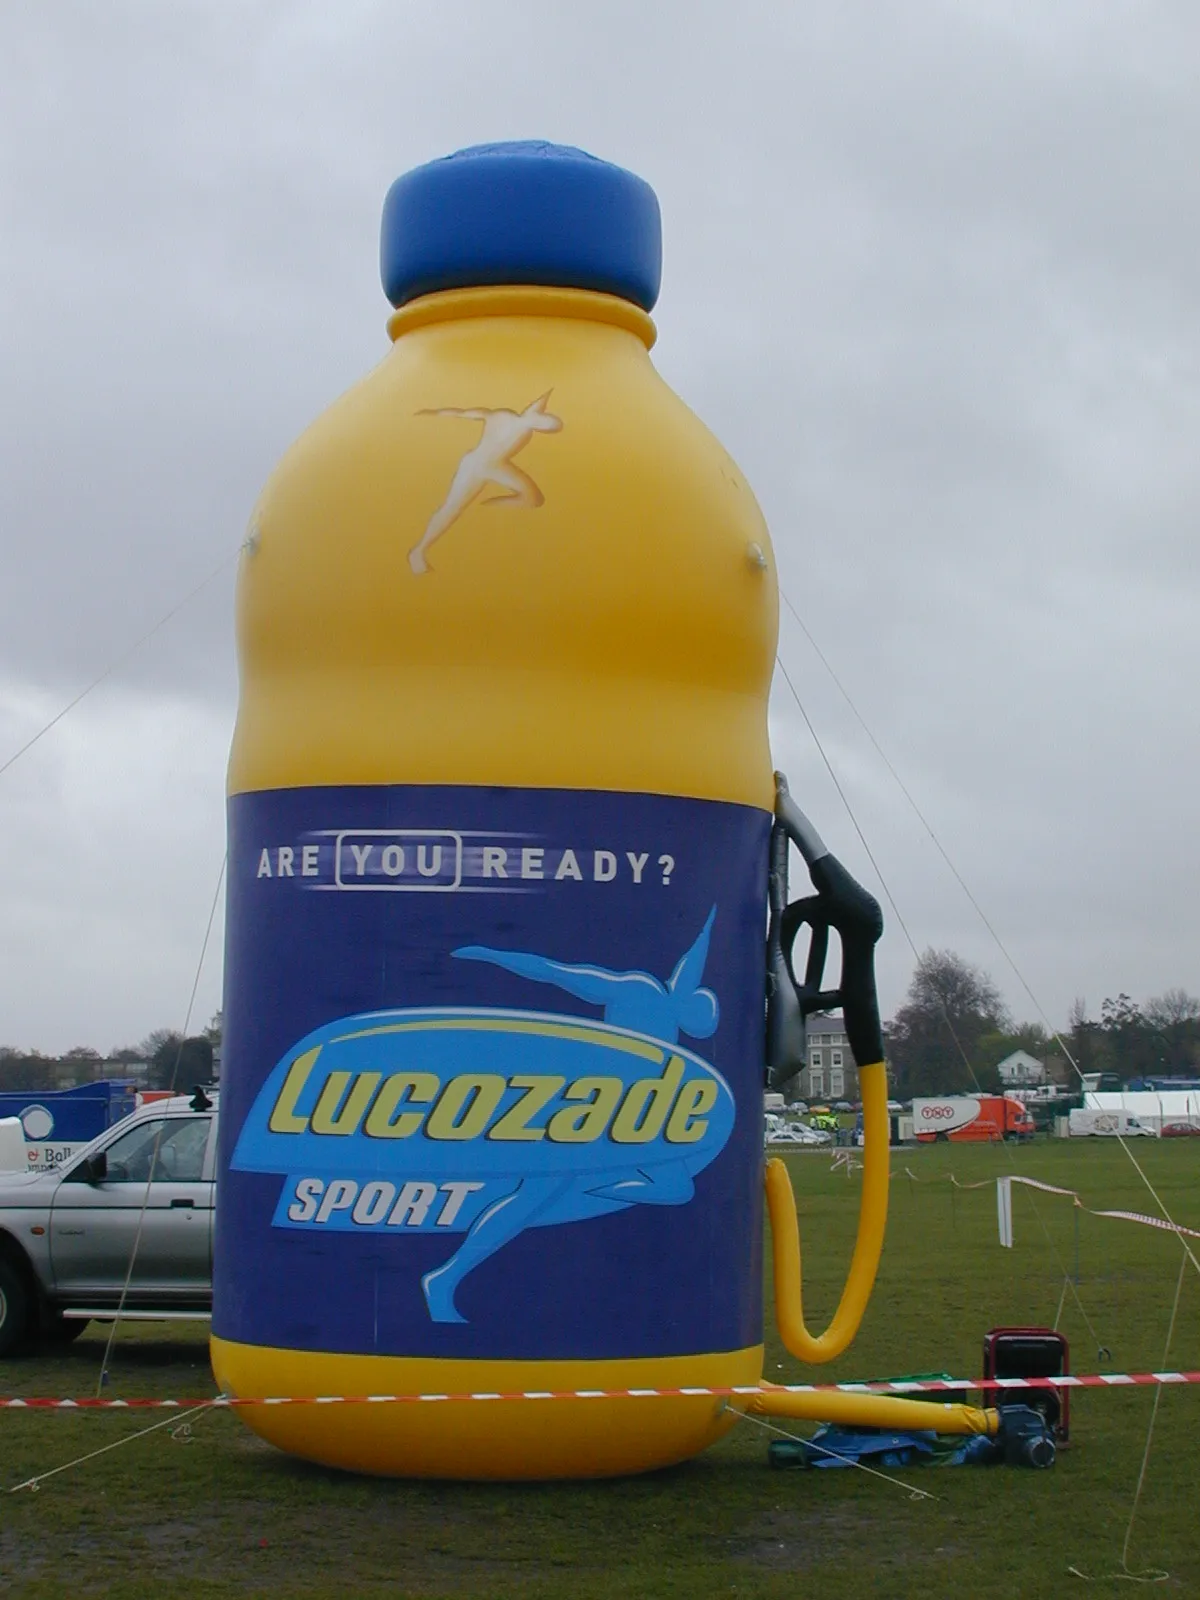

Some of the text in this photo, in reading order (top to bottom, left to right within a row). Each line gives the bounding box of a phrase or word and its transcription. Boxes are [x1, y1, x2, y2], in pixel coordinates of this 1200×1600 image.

[257, 844, 676, 885] ARE YOU READY?
[268, 1043, 719, 1145] Lucozade
[922, 1107, 953, 1119] TNT
[286, 1177, 487, 1228] SPORT
